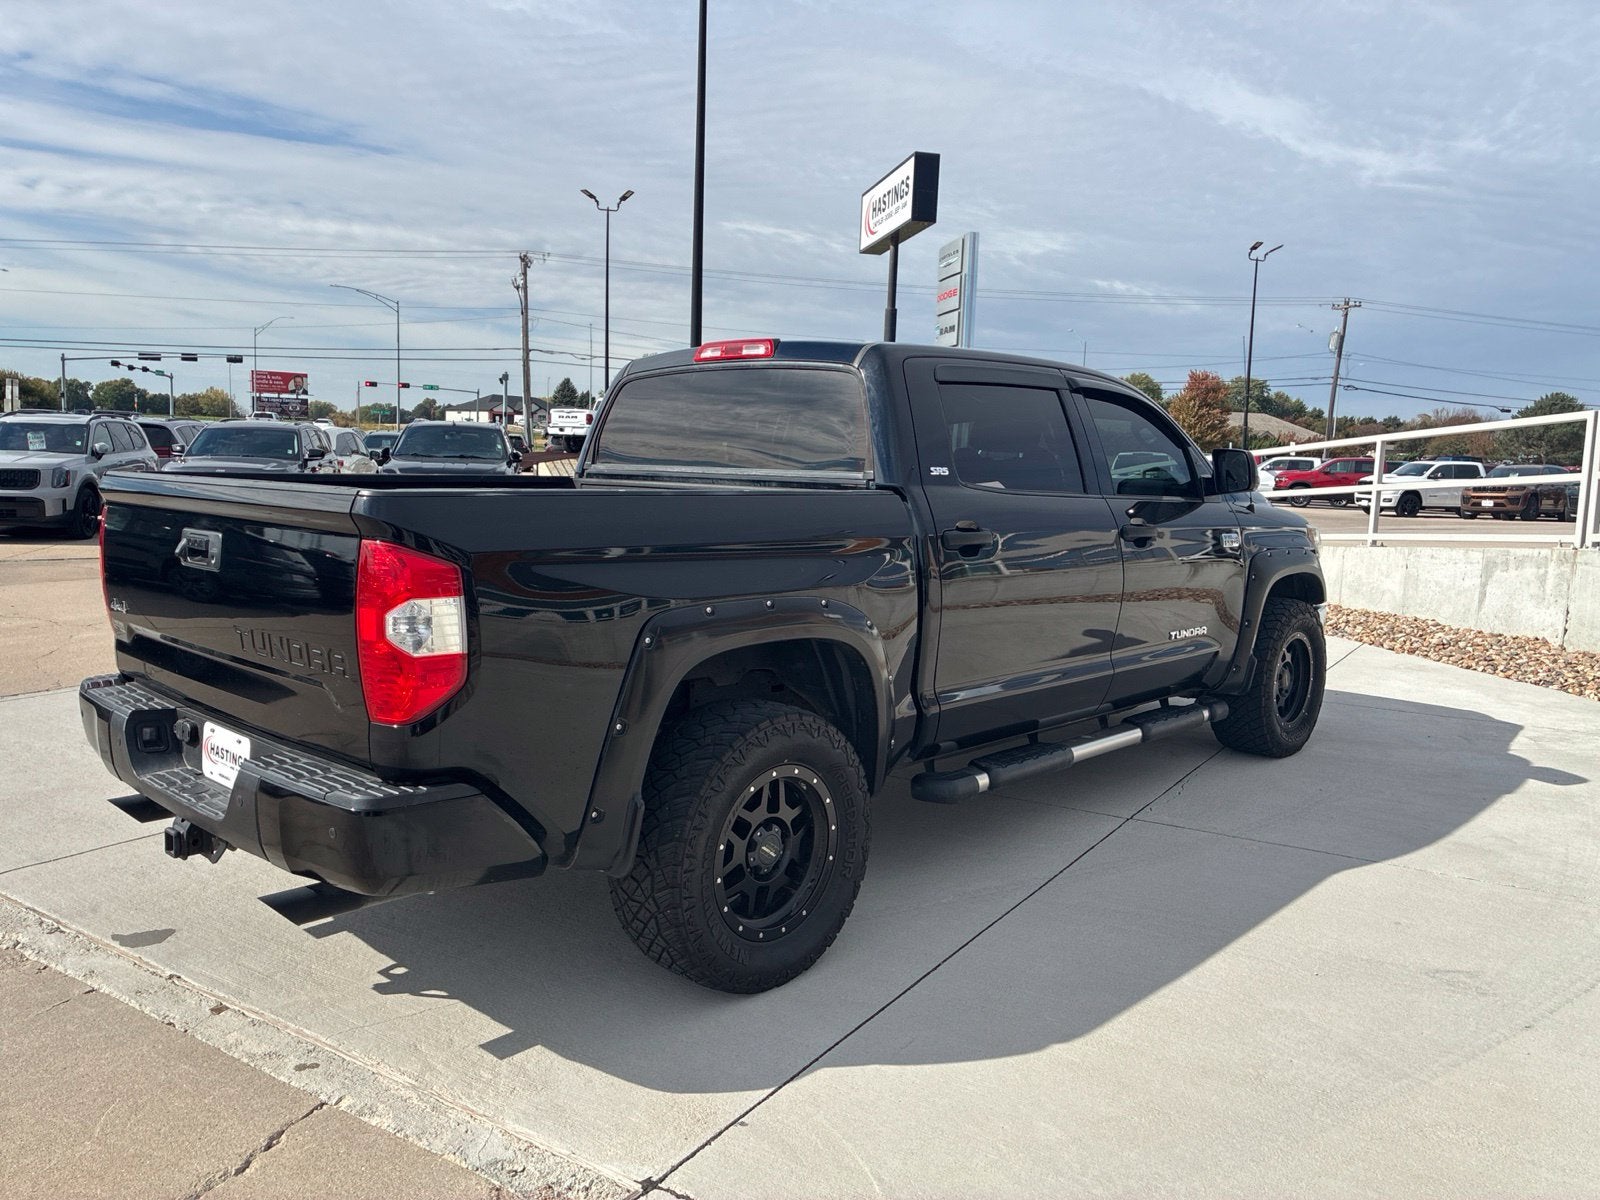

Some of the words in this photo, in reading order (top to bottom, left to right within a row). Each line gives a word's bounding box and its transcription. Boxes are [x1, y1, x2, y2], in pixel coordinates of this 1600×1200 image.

[871, 175, 910, 220] HASTINGS
[937, 288, 958, 303] DODGE
[940, 324, 956, 336] RAM
[1169, 626, 1208, 640] TUNDRA
[232, 624, 350, 679] TUNDRA
[210, 742, 247, 768] HASTING
